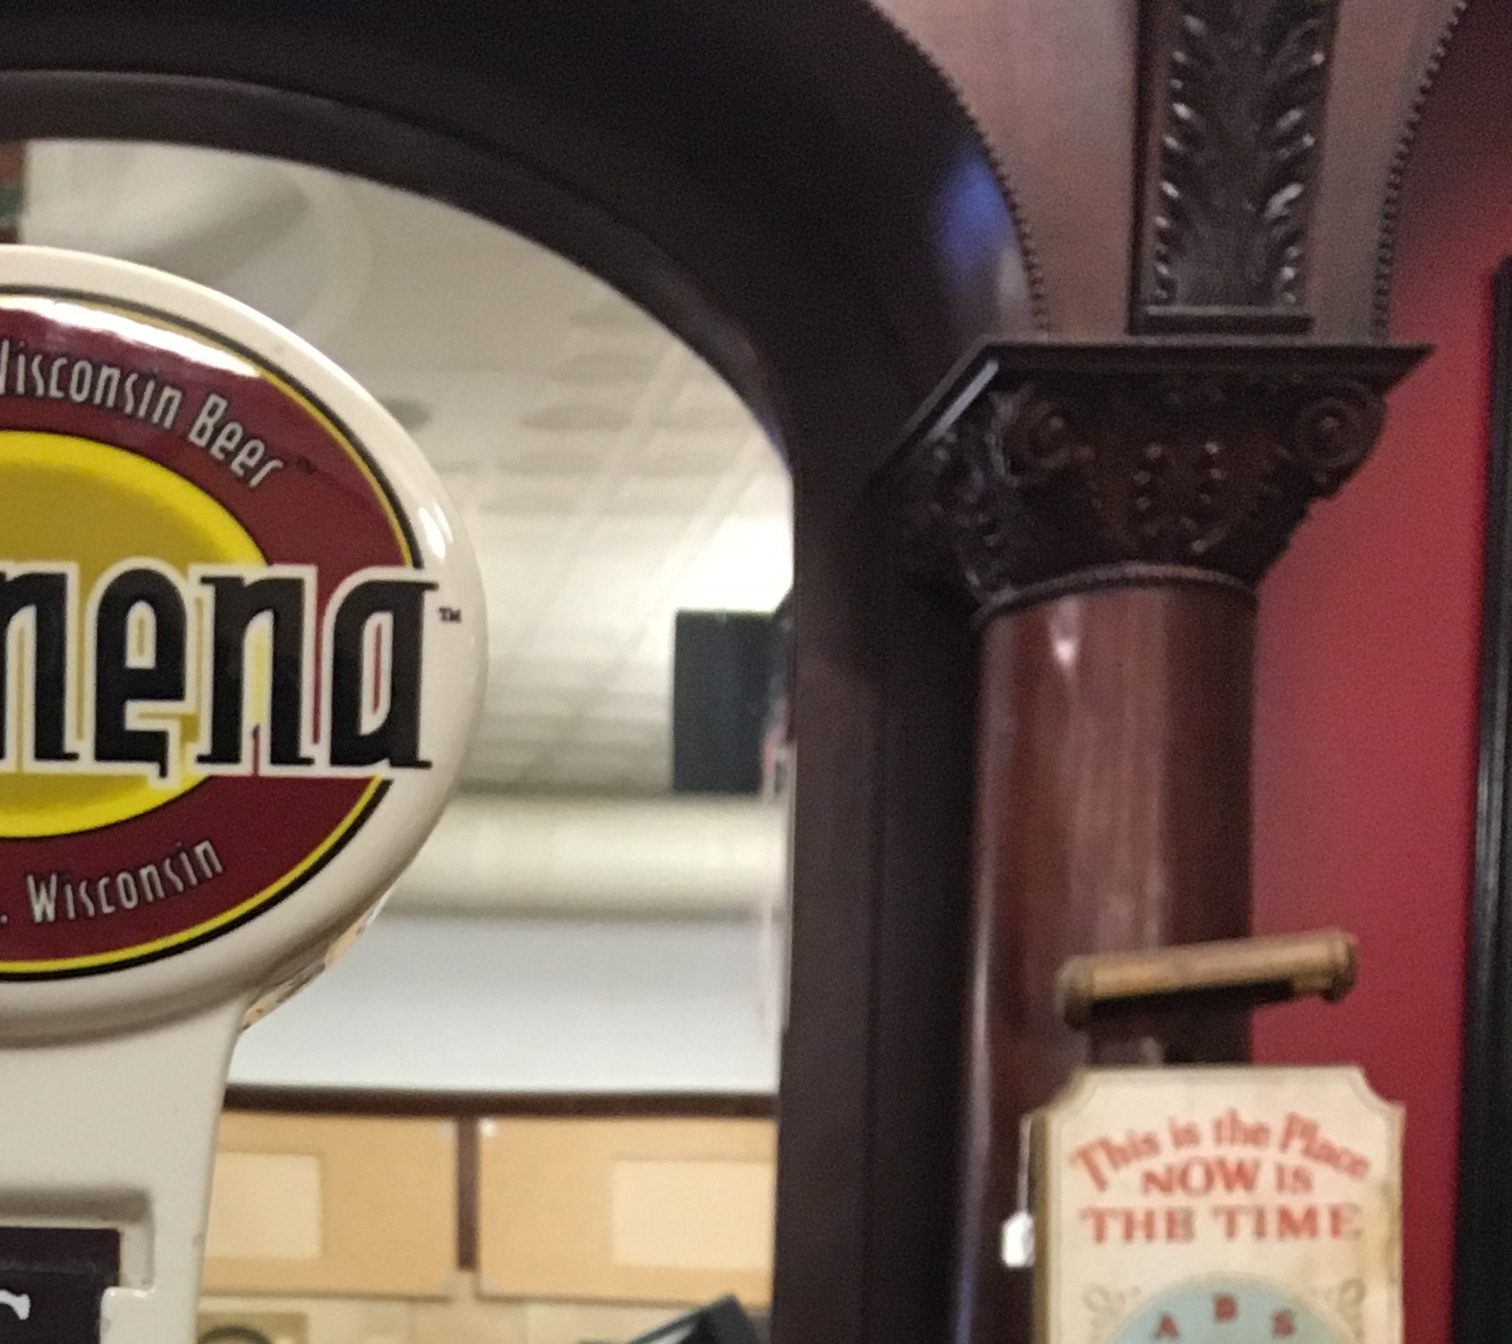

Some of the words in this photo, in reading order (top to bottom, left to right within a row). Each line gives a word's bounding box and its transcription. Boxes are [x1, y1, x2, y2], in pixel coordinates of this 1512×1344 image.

[189, 392, 284, 489] Beer
[26, 839, 224, 925] Wisconsin
[1070, 1131, 1160, 1193] This
[1168, 1115, 1201, 1150] is
[1212, 1107, 1271, 1147] the
[1279, 1111, 1370, 1178] Place
[1140, 1155, 1260, 1196] NOW
[1275, 1161, 1314, 1194] IS
[1081, 1203, 1195, 1245] THE
[1211, 1201, 1364, 1242] TIME
